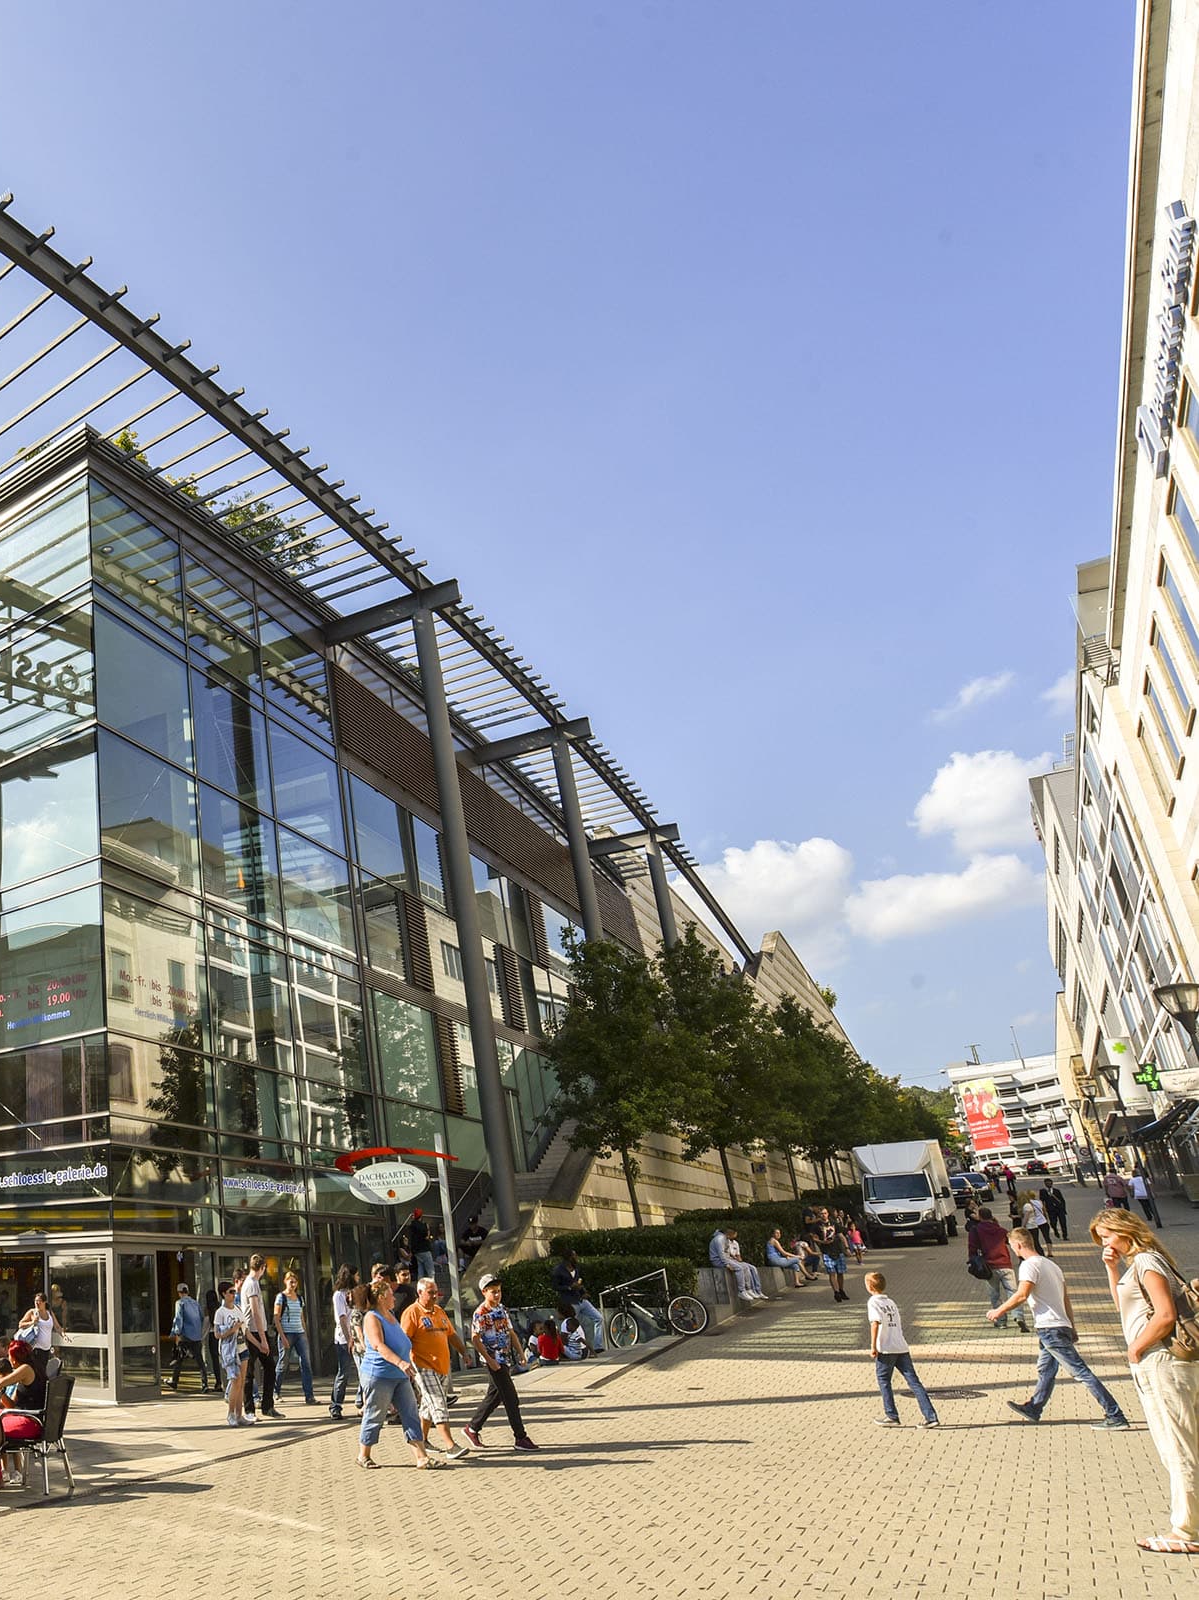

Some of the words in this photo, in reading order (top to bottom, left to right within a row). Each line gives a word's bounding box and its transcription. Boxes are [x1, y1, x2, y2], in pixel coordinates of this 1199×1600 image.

[119, 969, 147, 988] Mo.-Fr.
[151, 978, 162, 992] bis
[27, 983, 39, 995] bis
[27, 999, 40, 1010] bis
[46, 991, 71, 1006] 19.00
[152, 994, 162, 1008] bis
[358, 1169, 415, 1182] DACHGARTEN
[222, 1176, 306, 1195] www.schloessle-galerie.de
[359, 1177, 416, 1189] PANORAMABLICK
